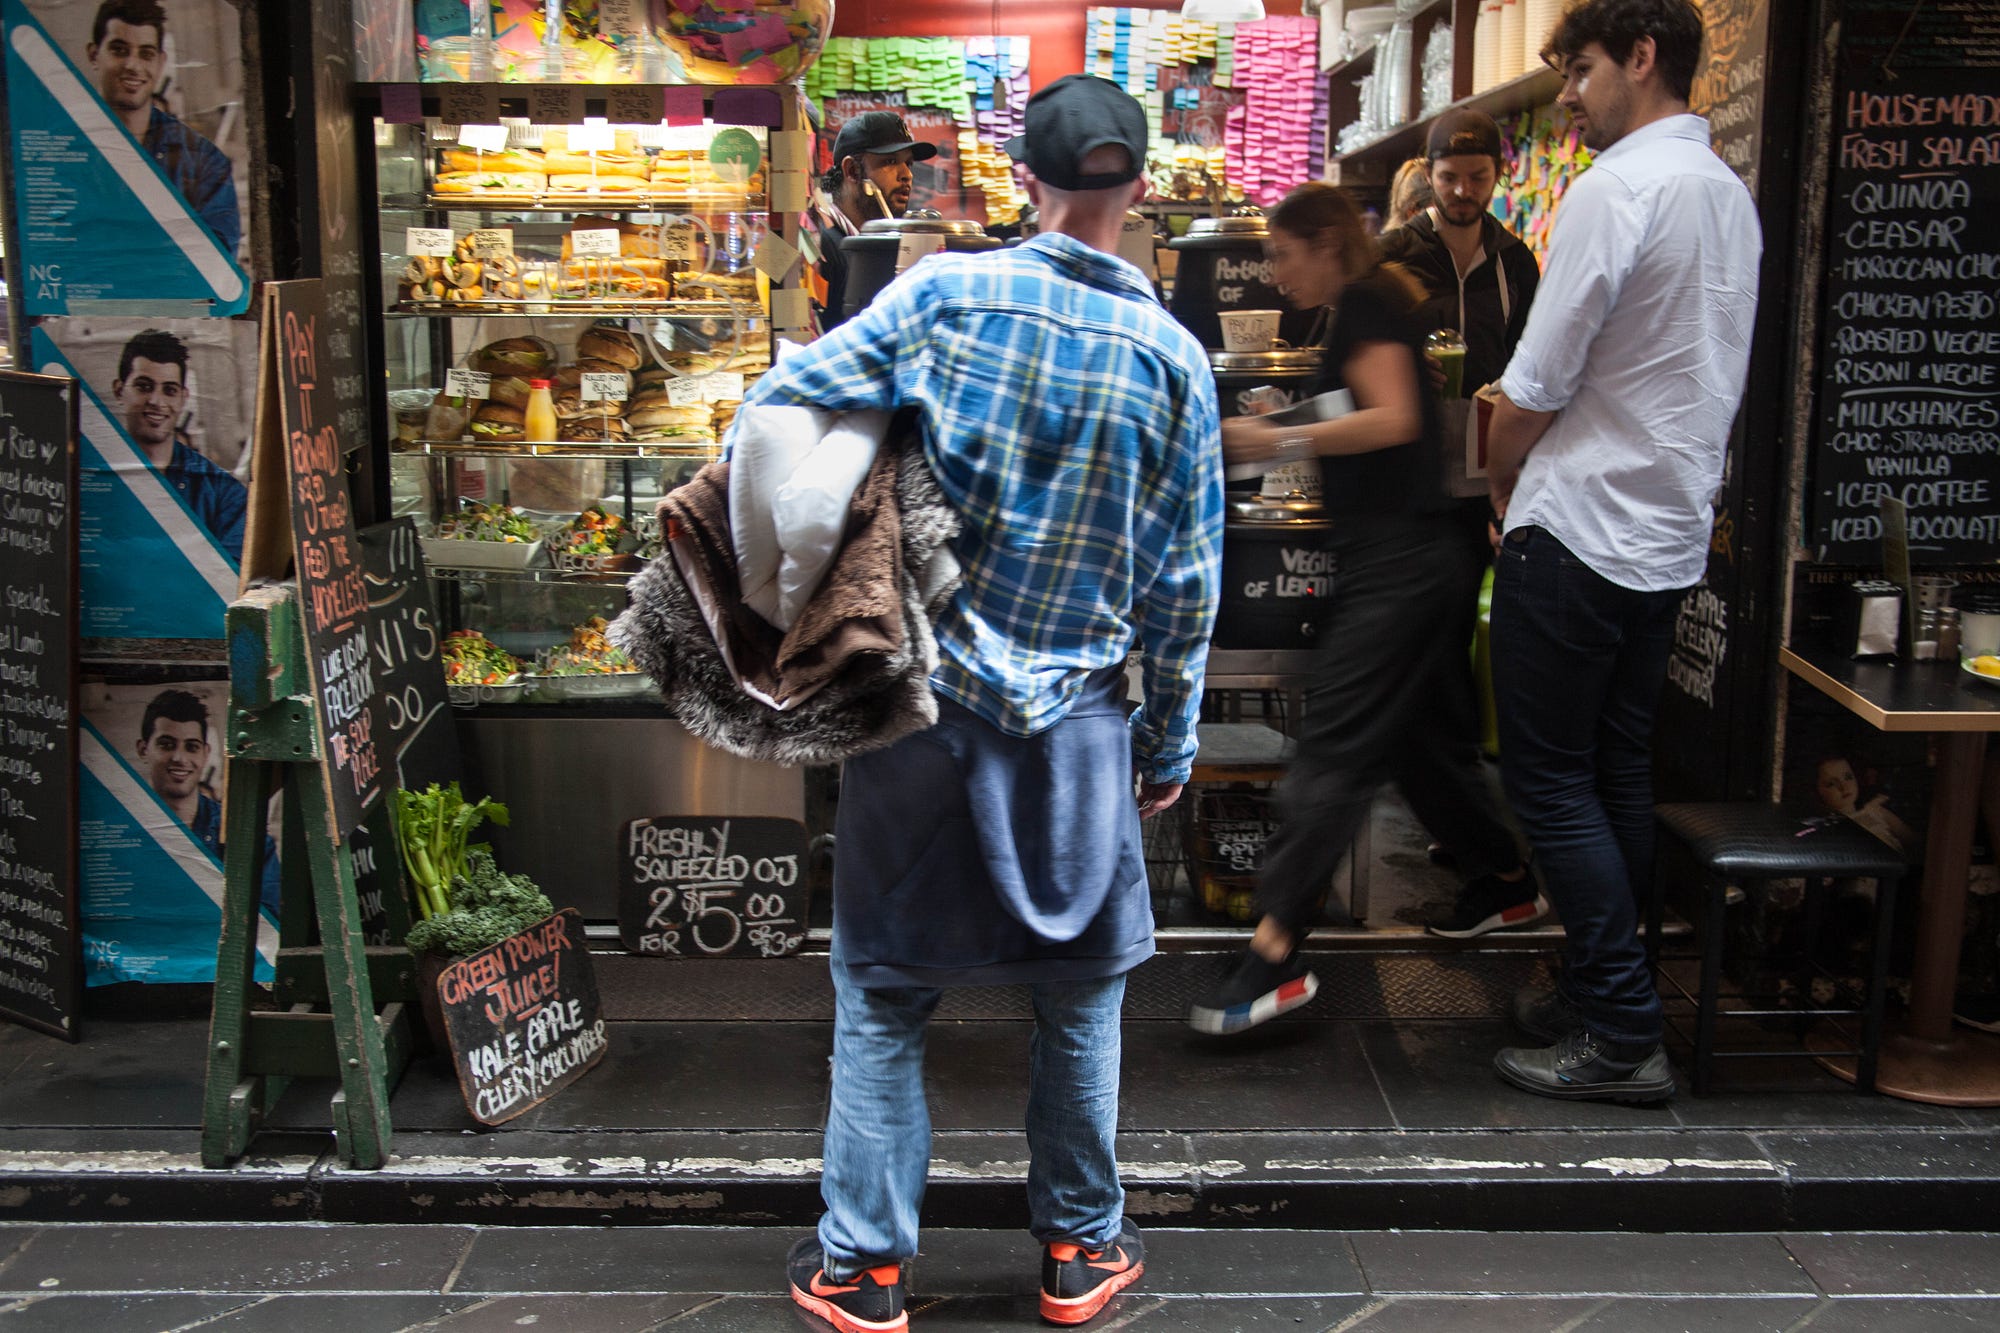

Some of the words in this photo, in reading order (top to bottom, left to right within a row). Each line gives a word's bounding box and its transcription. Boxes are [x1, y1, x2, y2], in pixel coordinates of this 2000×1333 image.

[1840, 132, 1908, 170] FRESH
[29, 264, 62, 281] NC
[36, 283, 62, 300] AT
[1933, 290, 1995, 320] PESTO
[285, 310, 317, 388] PAY
[1865, 455, 1951, 477] VANILLA
[1901, 480, 1991, 509] COFFEE
[311, 563, 369, 633] HOMELESS
[321, 648, 345, 684] LIKE
[342, 638, 358, 672] US
[354, 624, 369, 662] ON
[323, 656, 376, 729] FACEBOOK
[348, 706, 373, 753] SOUP
[629, 818, 730, 860] FRESHLY
[634, 854, 750, 884] SQUEEZED
[753, 854, 799, 887] OJ
[645, 886, 678, 929] 2
[441, 947, 508, 1007] GREEN
[504, 915, 573, 972] POWER
[639, 930, 682, 955] FOR
[484, 950, 562, 1024] JUICE!
[467, 1031, 522, 1090] KALE
[526, 998, 585, 1056] APPLE
[538, 1018, 609, 1088] CUCUMBER
